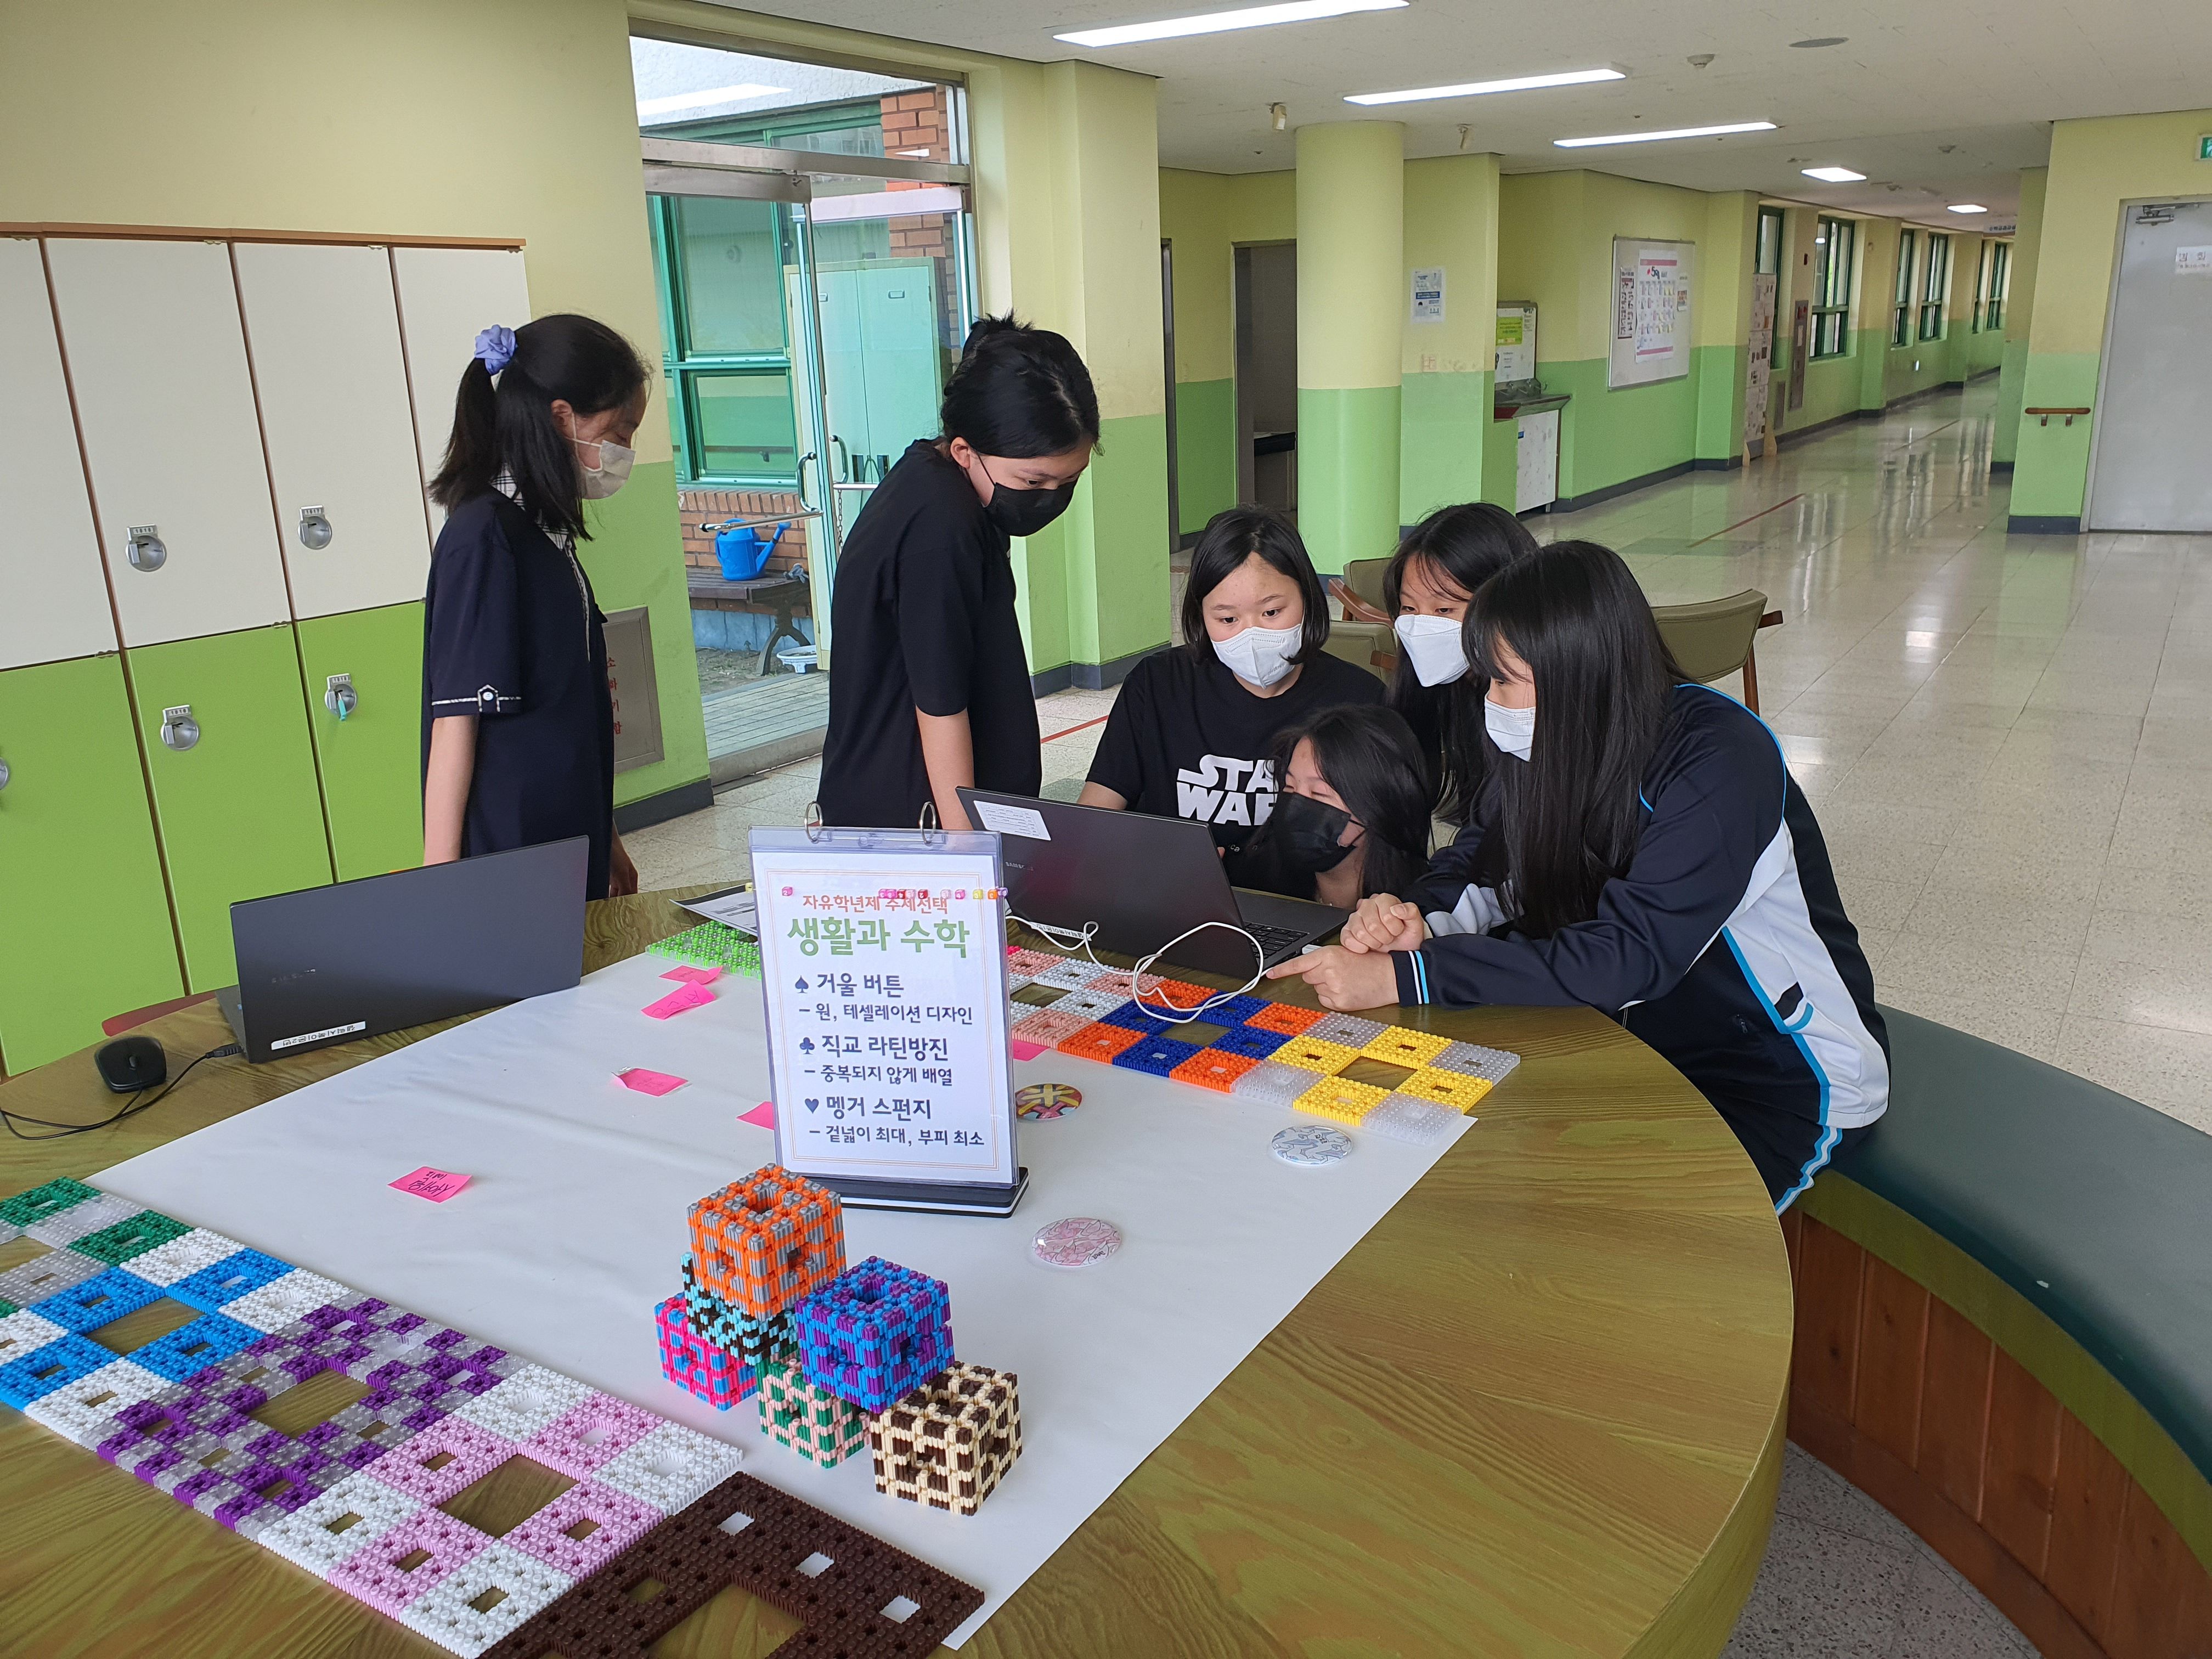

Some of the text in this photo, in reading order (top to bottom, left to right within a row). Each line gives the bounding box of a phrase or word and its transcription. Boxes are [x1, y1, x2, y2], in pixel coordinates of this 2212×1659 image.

[1177, 754, 1278, 793] STA
[1176, 781, 1278, 826] WAR
[803, 895, 880, 912] 자유학년제
[787, 916, 970, 958] 생활과 수학
[817, 972, 904, 998] 거울 버튼
[815, 1003, 973, 1025] 원, 테셀레이션 디자인
[283, 1025, 356, 1046] 갤럭시북이온2번
[822, 1035, 948, 1062] 직교 라틴방진
[820, 1065, 952, 1086] 중복되지 않게 배열
[826, 1096, 931, 1121] 멩거 스펀지
[826, 1125, 985, 1147] 겉넓이 최대, 부피 최소
